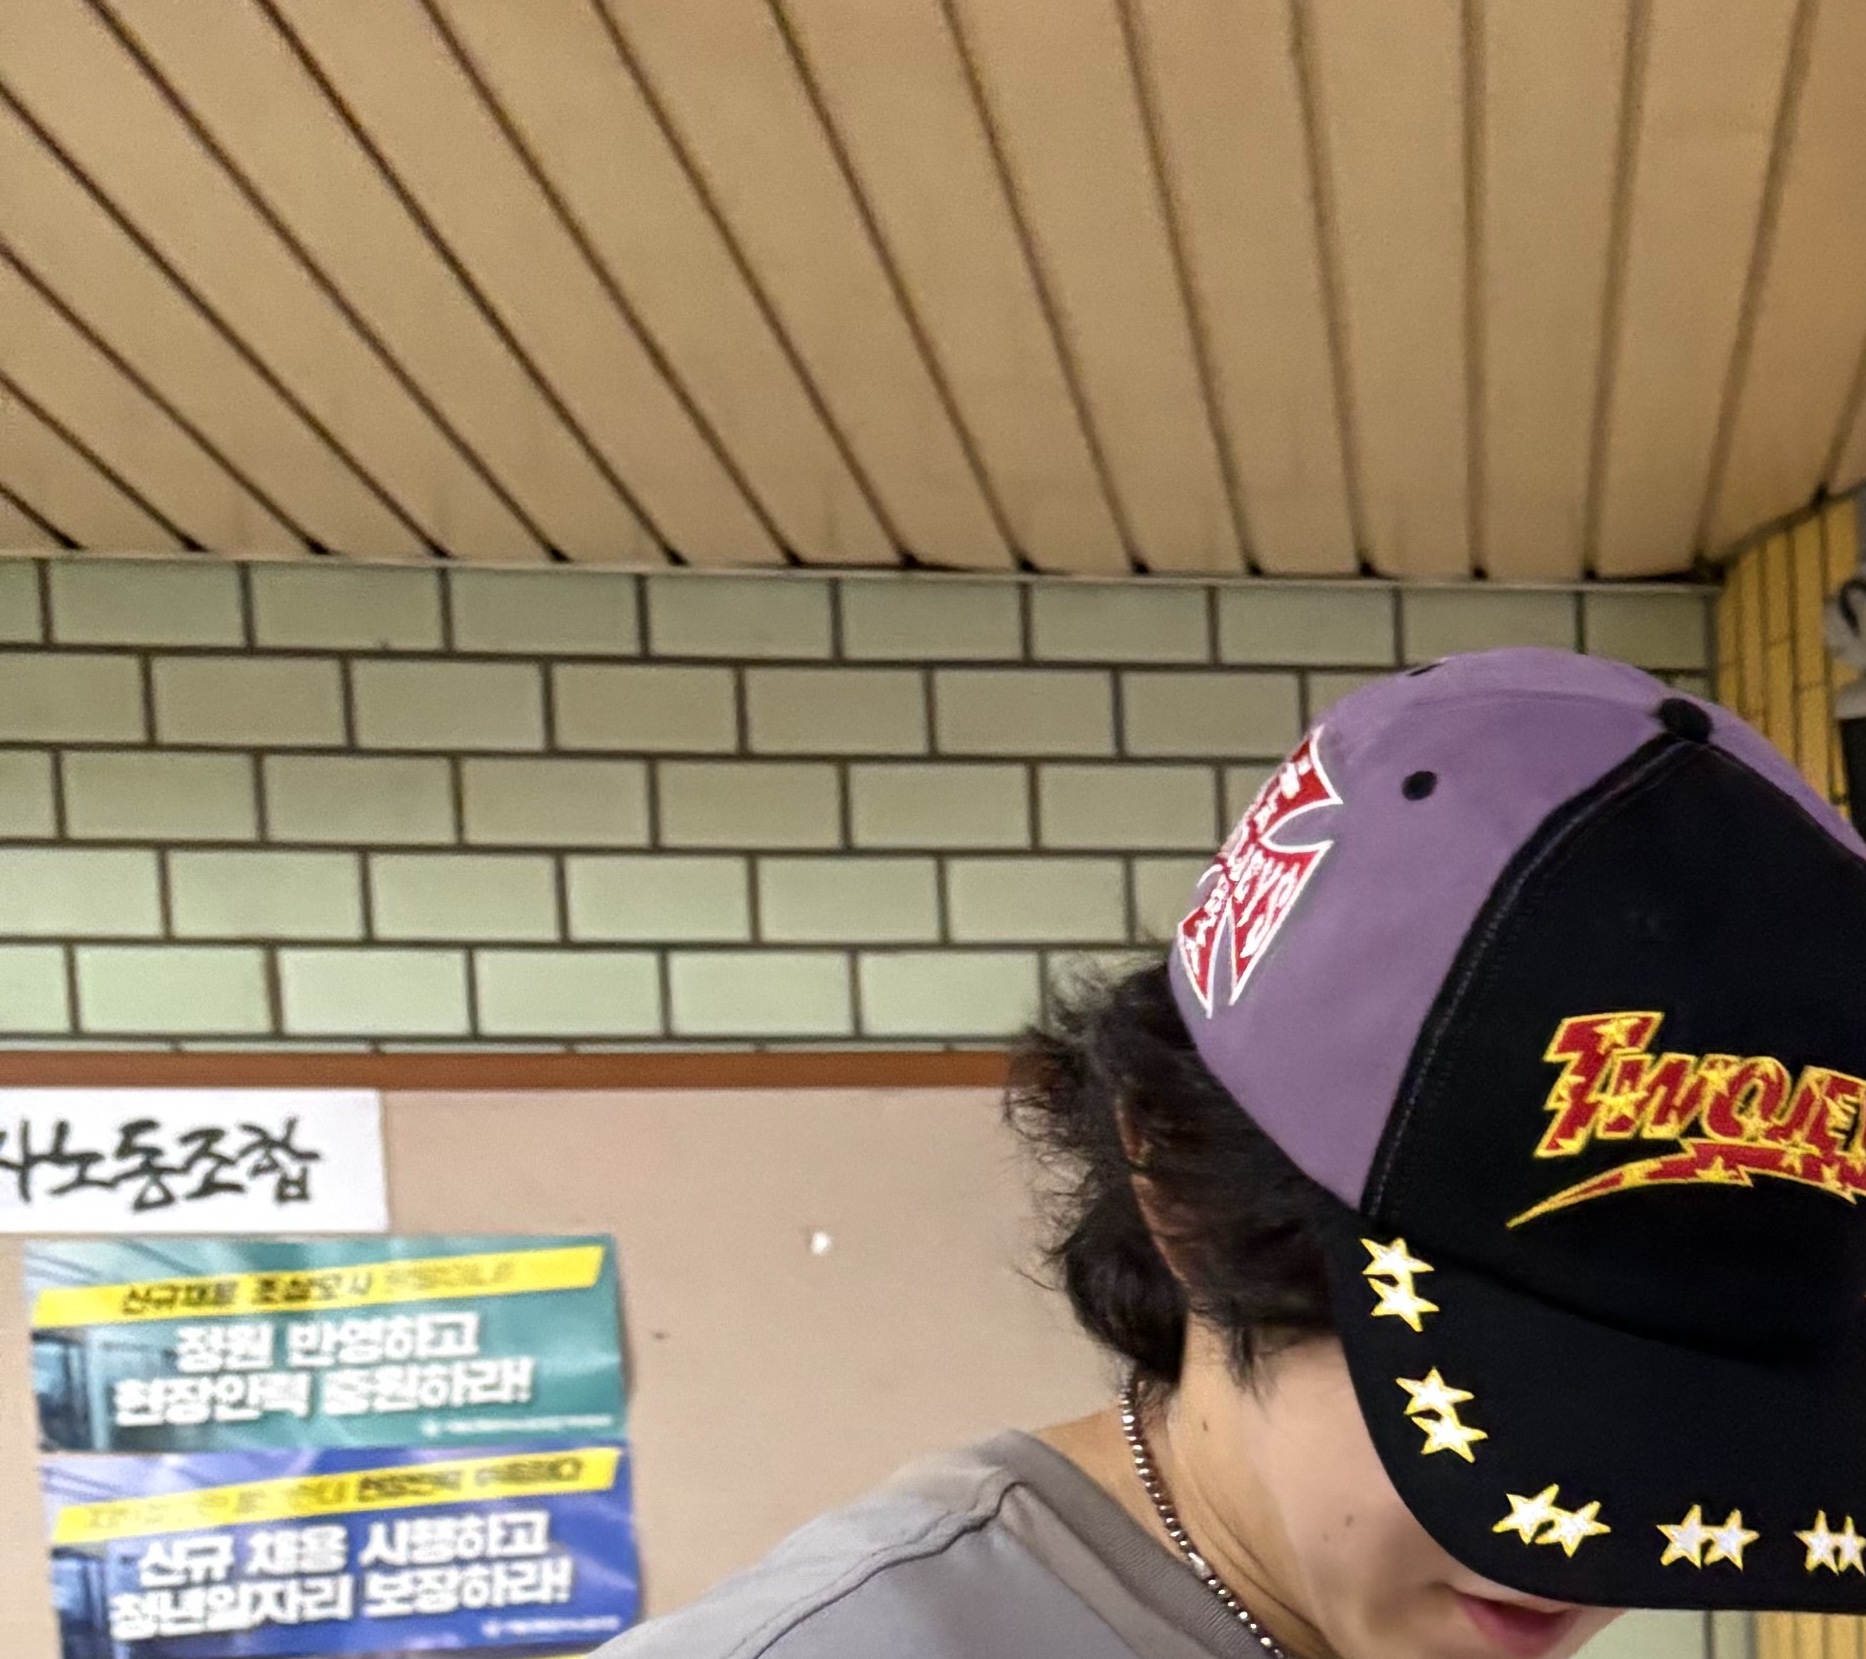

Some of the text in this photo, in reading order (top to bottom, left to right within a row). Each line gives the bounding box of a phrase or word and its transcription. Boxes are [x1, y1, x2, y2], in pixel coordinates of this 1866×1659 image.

[176, 1311, 479, 1372] 정원 반영하고
[138, 1509, 551, 1590] 신규 채용 시행하고
[110, 1557, 573, 1642] 청년일자리 보장하라!
